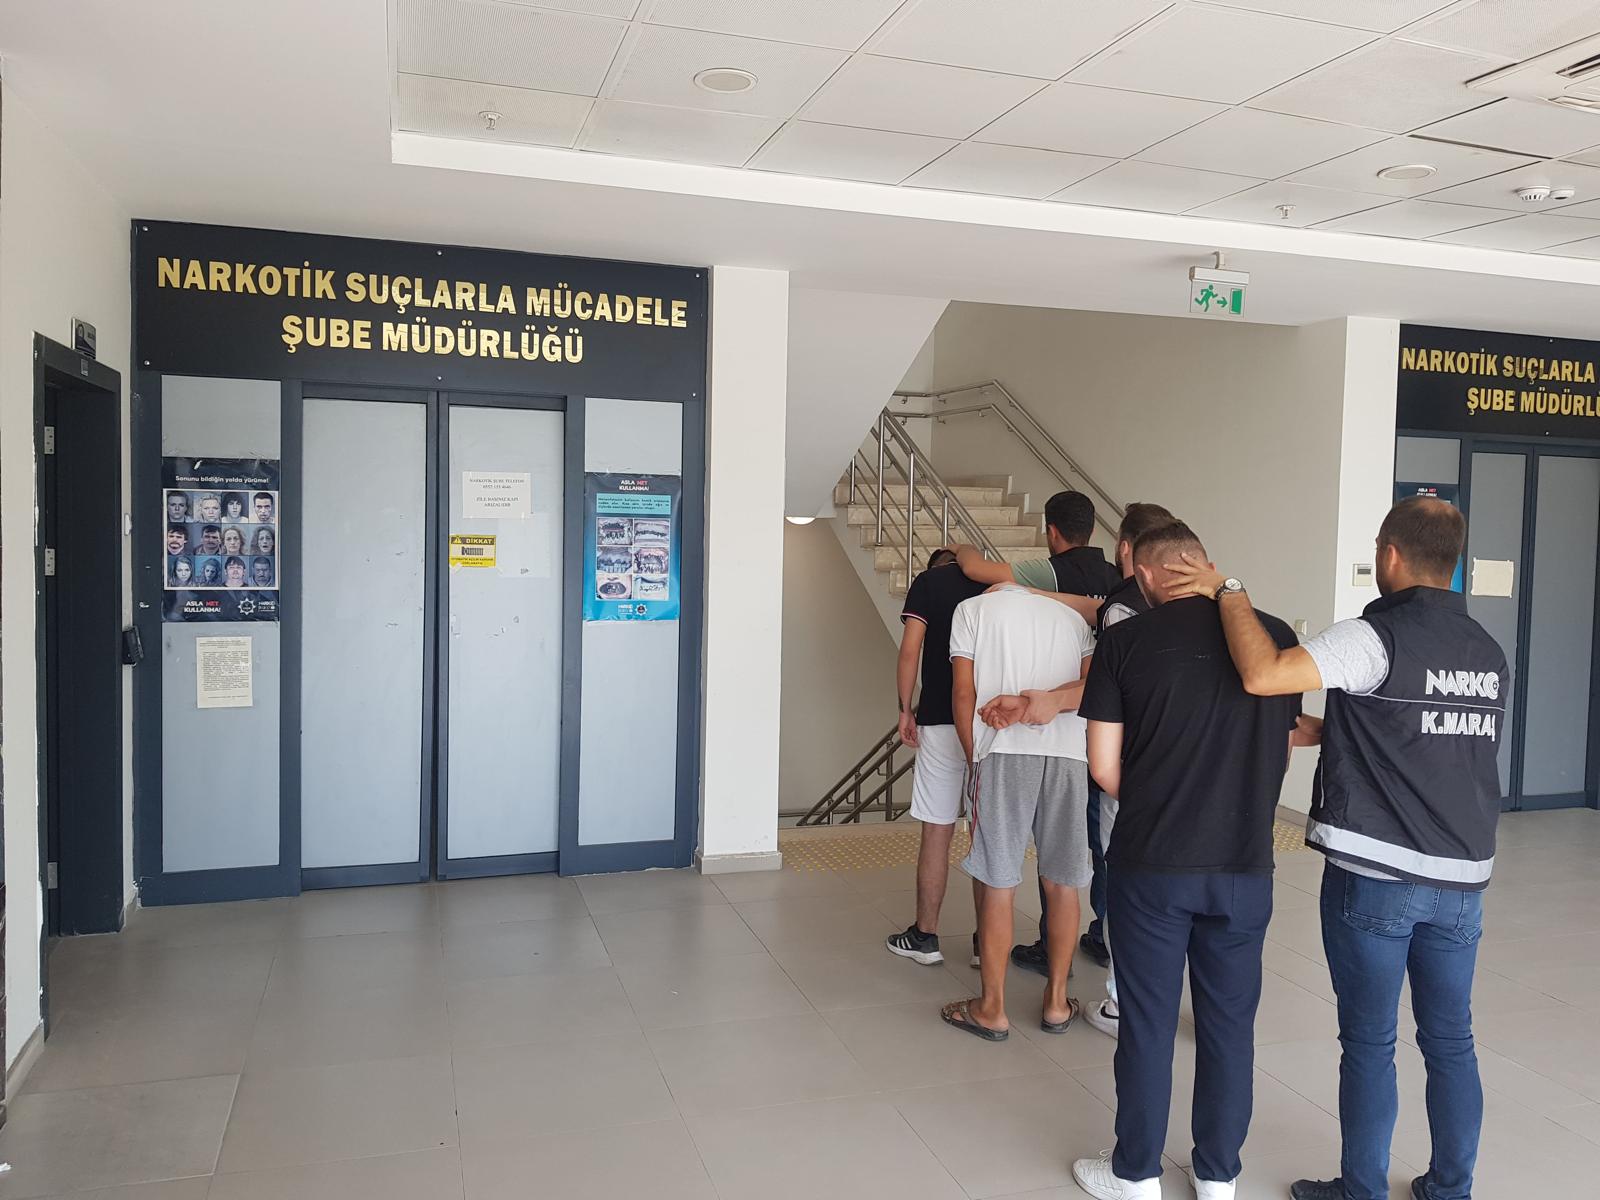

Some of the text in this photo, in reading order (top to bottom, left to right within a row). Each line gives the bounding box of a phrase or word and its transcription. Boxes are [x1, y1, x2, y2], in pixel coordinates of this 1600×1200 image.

[157, 257, 687, 328] NARKOTİK SUÇLARLA MÜCADELE
[281, 315, 584, 363] ŞUBE MÜDÜRLÜĞÜ
[1402, 347, 1596, 384] NARKOTİK SUÇLARLA
[1467, 387, 1516, 415] ŞUBE
[466, 537, 493, 545] DİKKAT
